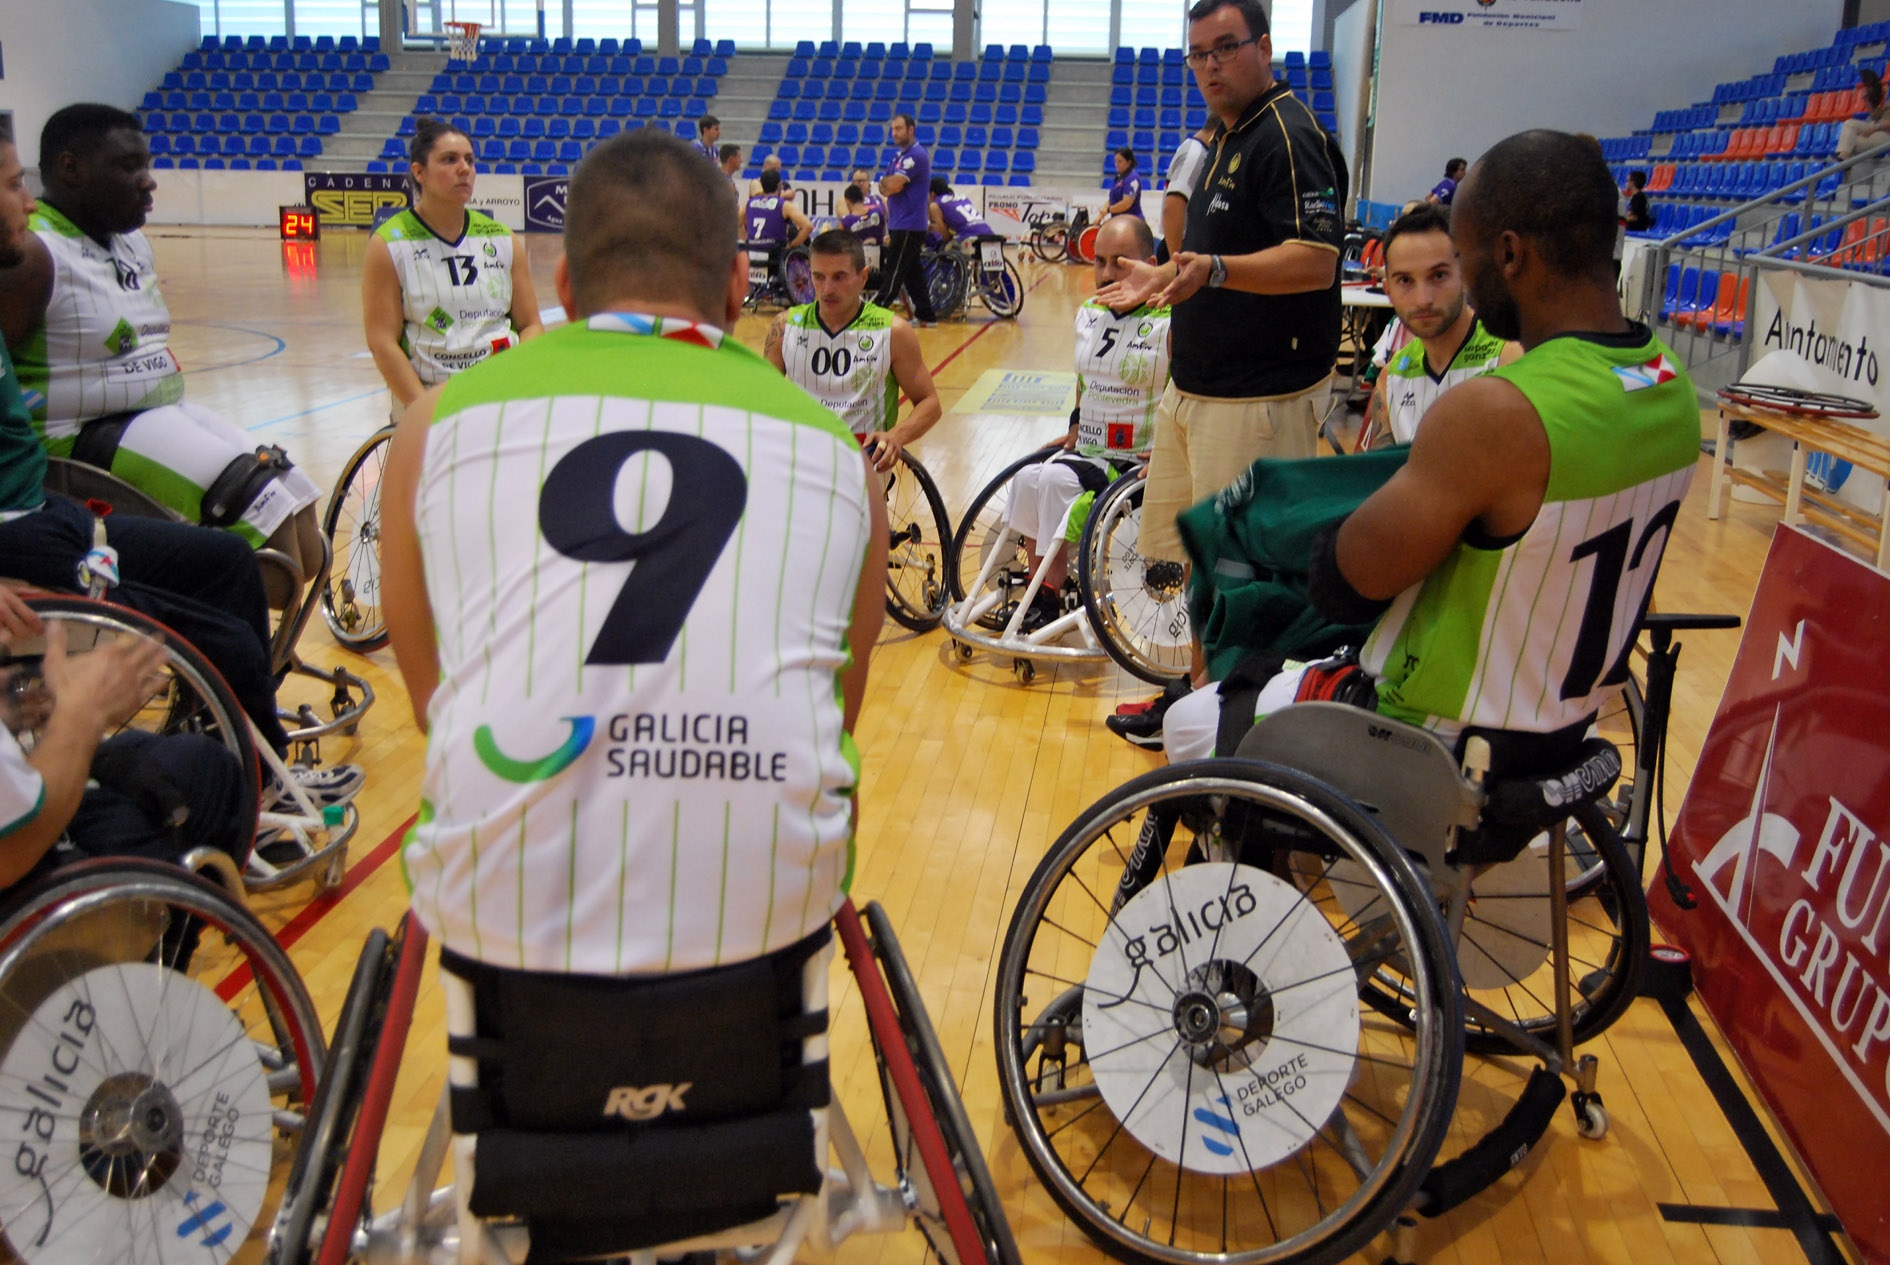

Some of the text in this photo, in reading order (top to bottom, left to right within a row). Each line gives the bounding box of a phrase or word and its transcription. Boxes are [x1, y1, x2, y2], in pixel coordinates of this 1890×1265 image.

[1419, 12, 1464, 24] FMD
[308, 177, 410, 188] CADENA
[311, 190, 407, 225] SER
[486, 198, 520, 206] ARROYO
[956, 203, 983, 223] 12
[988, 201, 1018, 209] PROMO
[286, 215, 313, 235] 24
[753, 218, 766, 239] 7
[441, 255, 479, 286] 13
[434, 349, 487, 360] CONCELLO
[1095, 328, 1119, 358] 5
[121, 356, 168, 374] DE VIGO
[811, 347, 851, 377] 00
[1089, 380, 1140, 397] Deputación
[1080, 424, 1102, 436] CELLO
[538, 430, 748, 667] 9
[1559, 500, 1680, 702] 12
[1772, 619, 1805, 681] N
[608, 714, 748, 745] GALICIA
[607, 749, 788, 782] SAUDABLE
[1097, 882, 1257, 1008] galicia
[1780, 899, 1890, 1105] GRUP
[1236, 1053, 1309, 1101] DEPORTE
[602, 1082, 693, 1121] RGK
[1242, 1075, 1307, 1118] GALEGO
[15, 1000, 97, 1247] galicia
[193, 1091, 229, 1182] DEPORTE
[208, 1107, 240, 1188] GALEGO
